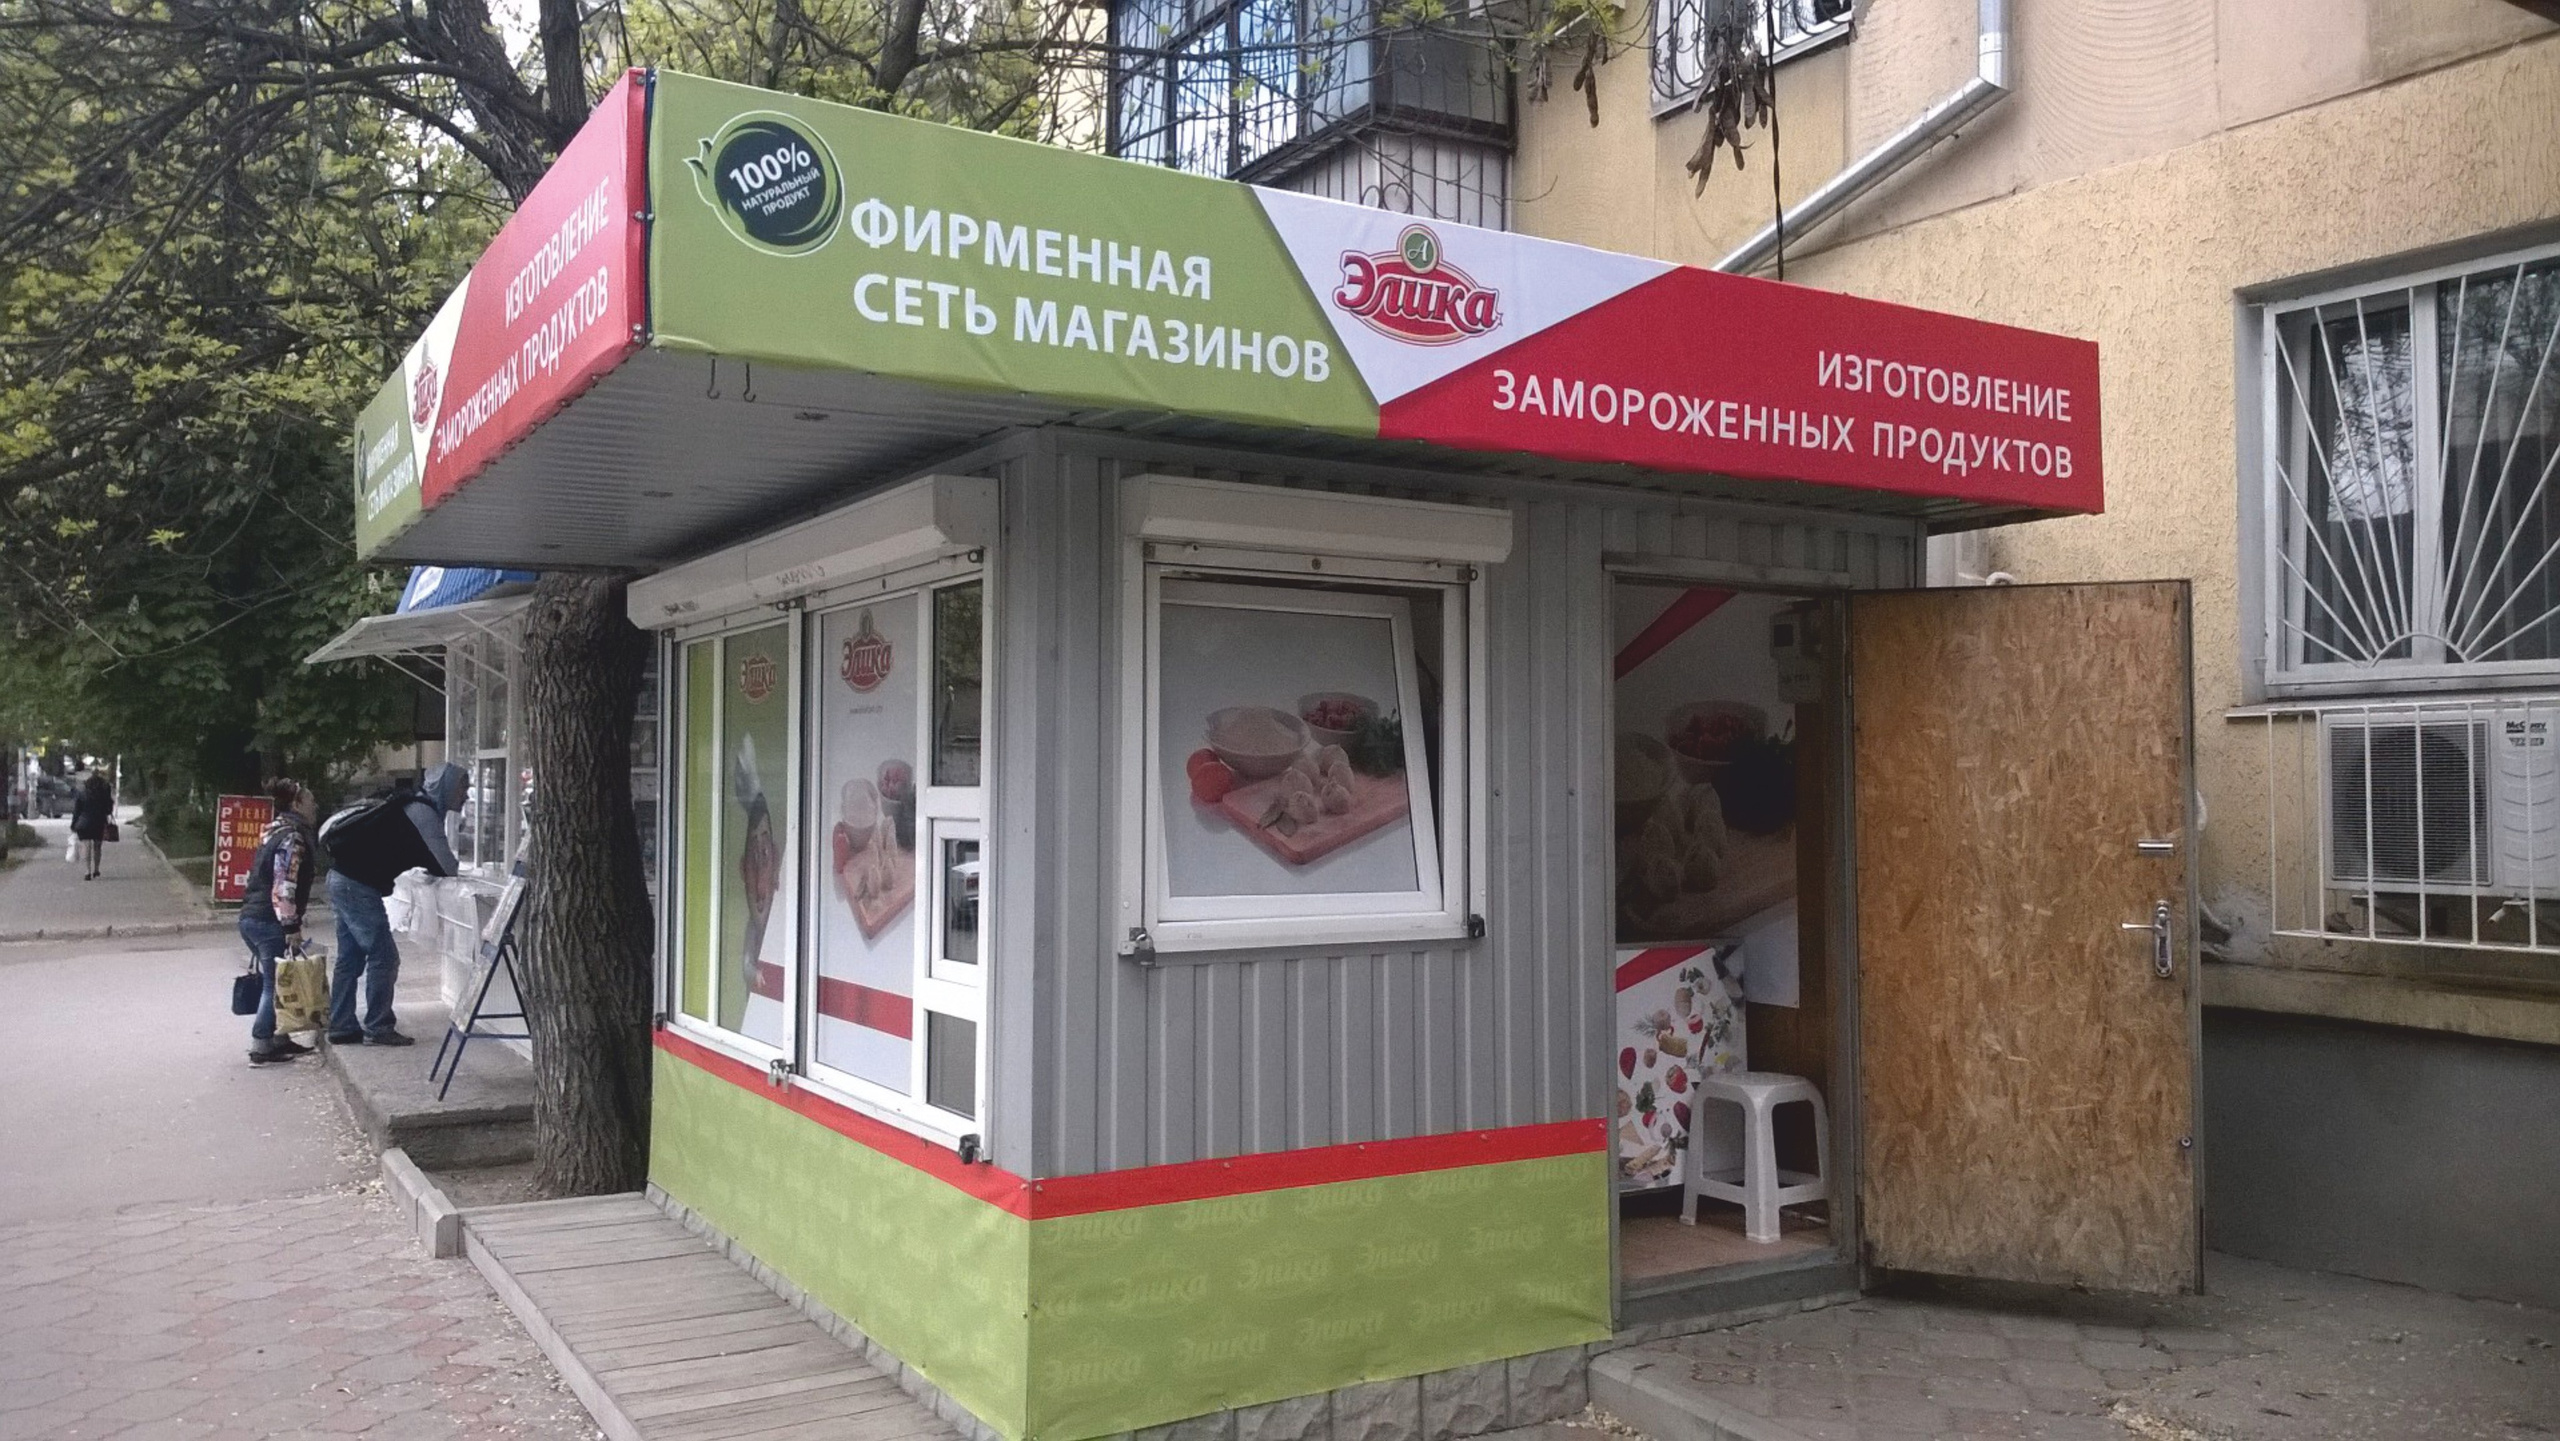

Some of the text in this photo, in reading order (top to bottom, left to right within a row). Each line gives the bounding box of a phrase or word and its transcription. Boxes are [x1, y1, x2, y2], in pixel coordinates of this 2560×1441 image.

[729, 142, 811, 195] 100%
[741, 167, 821, 211] НАТУРАЛЬНЫЙ
[762, 186, 810, 217] ПРОДУКТ
[505, 176, 610, 329] ИЗГОТОВЛЕНИЕ
[851, 198, 1211, 300] ФИРМЕННАЯ
[853, 273, 1330, 382] СЕТЬ МАГАЗИНОВ
[1335, 254, 1500, 335] Элика
[436, 349, 519, 464] ЗАМОРОЖЕННЫХ
[522, 265, 609, 378] ПРОДУКТОВ
[1817, 349, 2072, 423] ИЗГОТОВЛЕНИЕ
[1493, 370, 2073, 478] ЗАМОРОЖЕННЫХ ПРОДУКТОВ
[217, 806, 233, 891] РЕМОНТ
